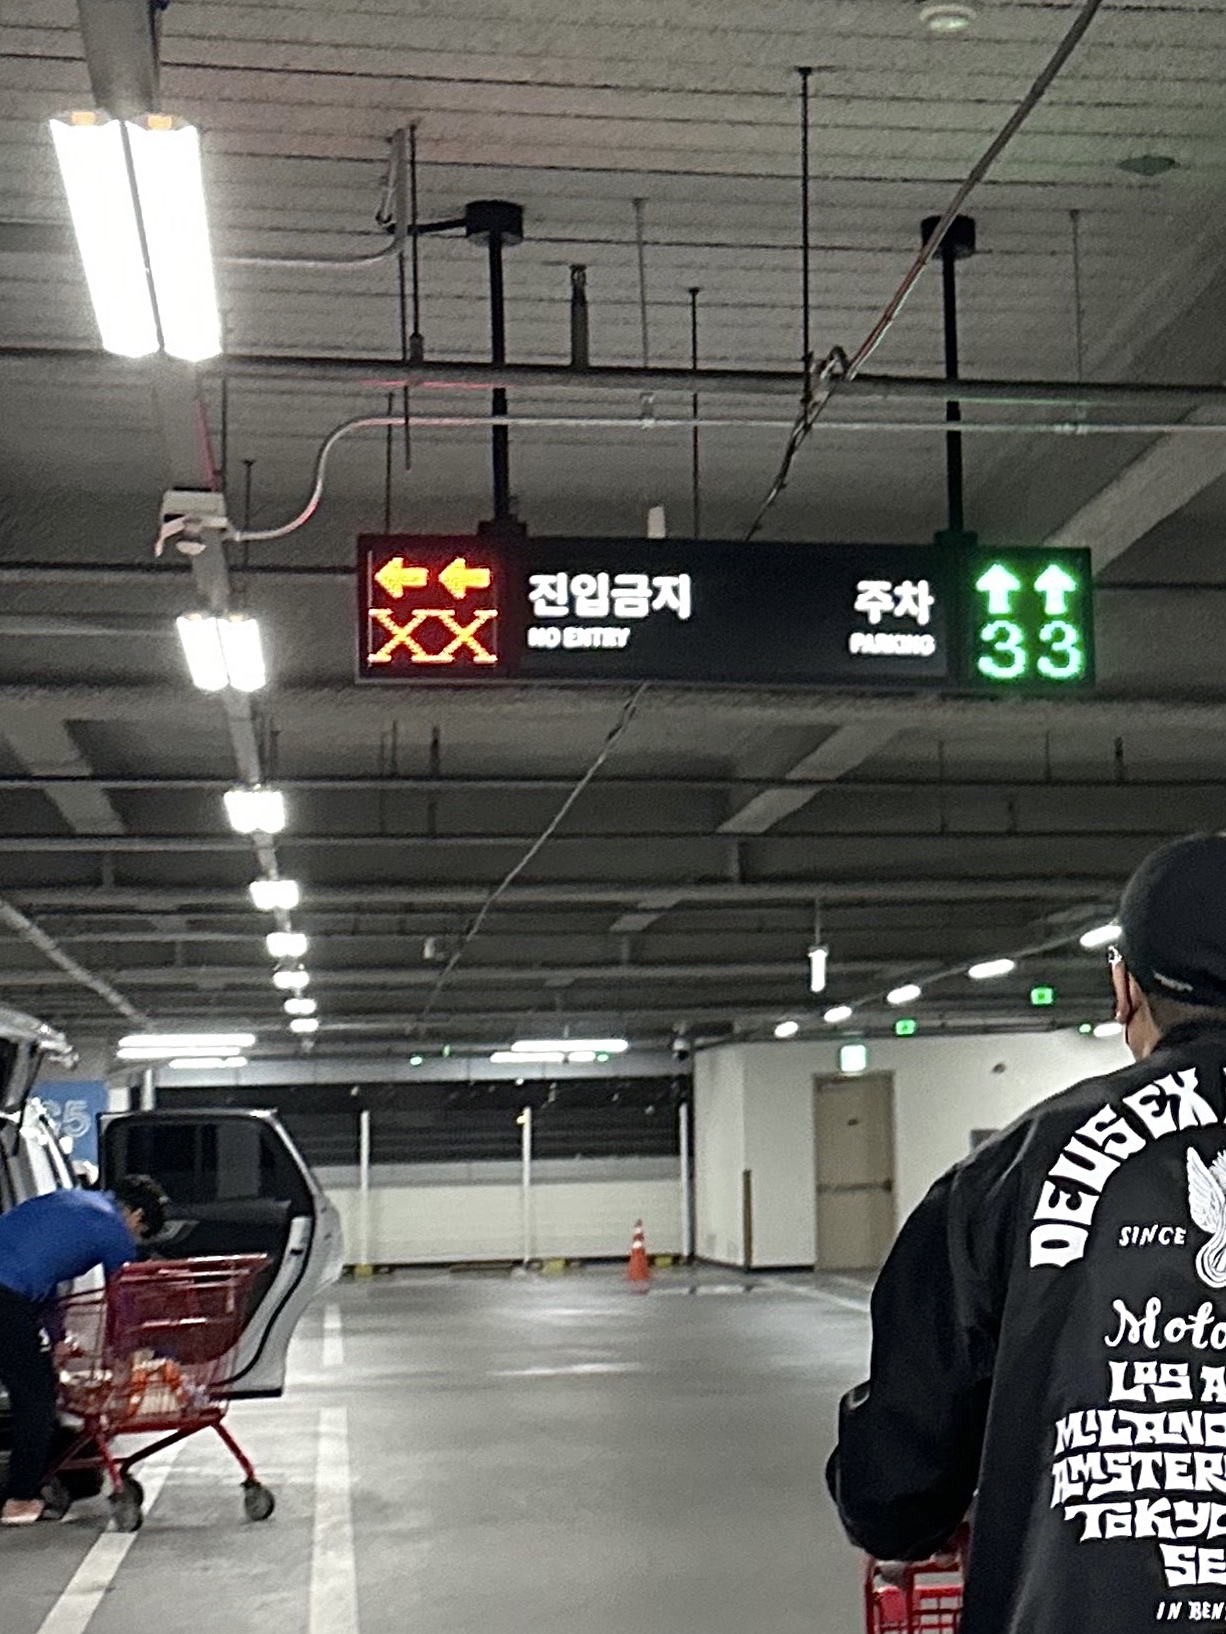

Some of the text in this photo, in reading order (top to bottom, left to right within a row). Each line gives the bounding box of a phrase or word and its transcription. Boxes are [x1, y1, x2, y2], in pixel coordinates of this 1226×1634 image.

[528, 572, 691, 620] 진입금지
[854, 580, 935, 626] 주차
[527, 626, 631, 649] NO ENTRY
[849, 632, 936, 657] PARKING
[1030, 1104, 1147, 1268] DEUS
[1122, 1067, 1218, 1140] EX
[1118, 1225, 1187, 1247] SINCE
[1108, 1361, 1193, 1404] LOS
[1156, 1601, 1183, 1620] IN
